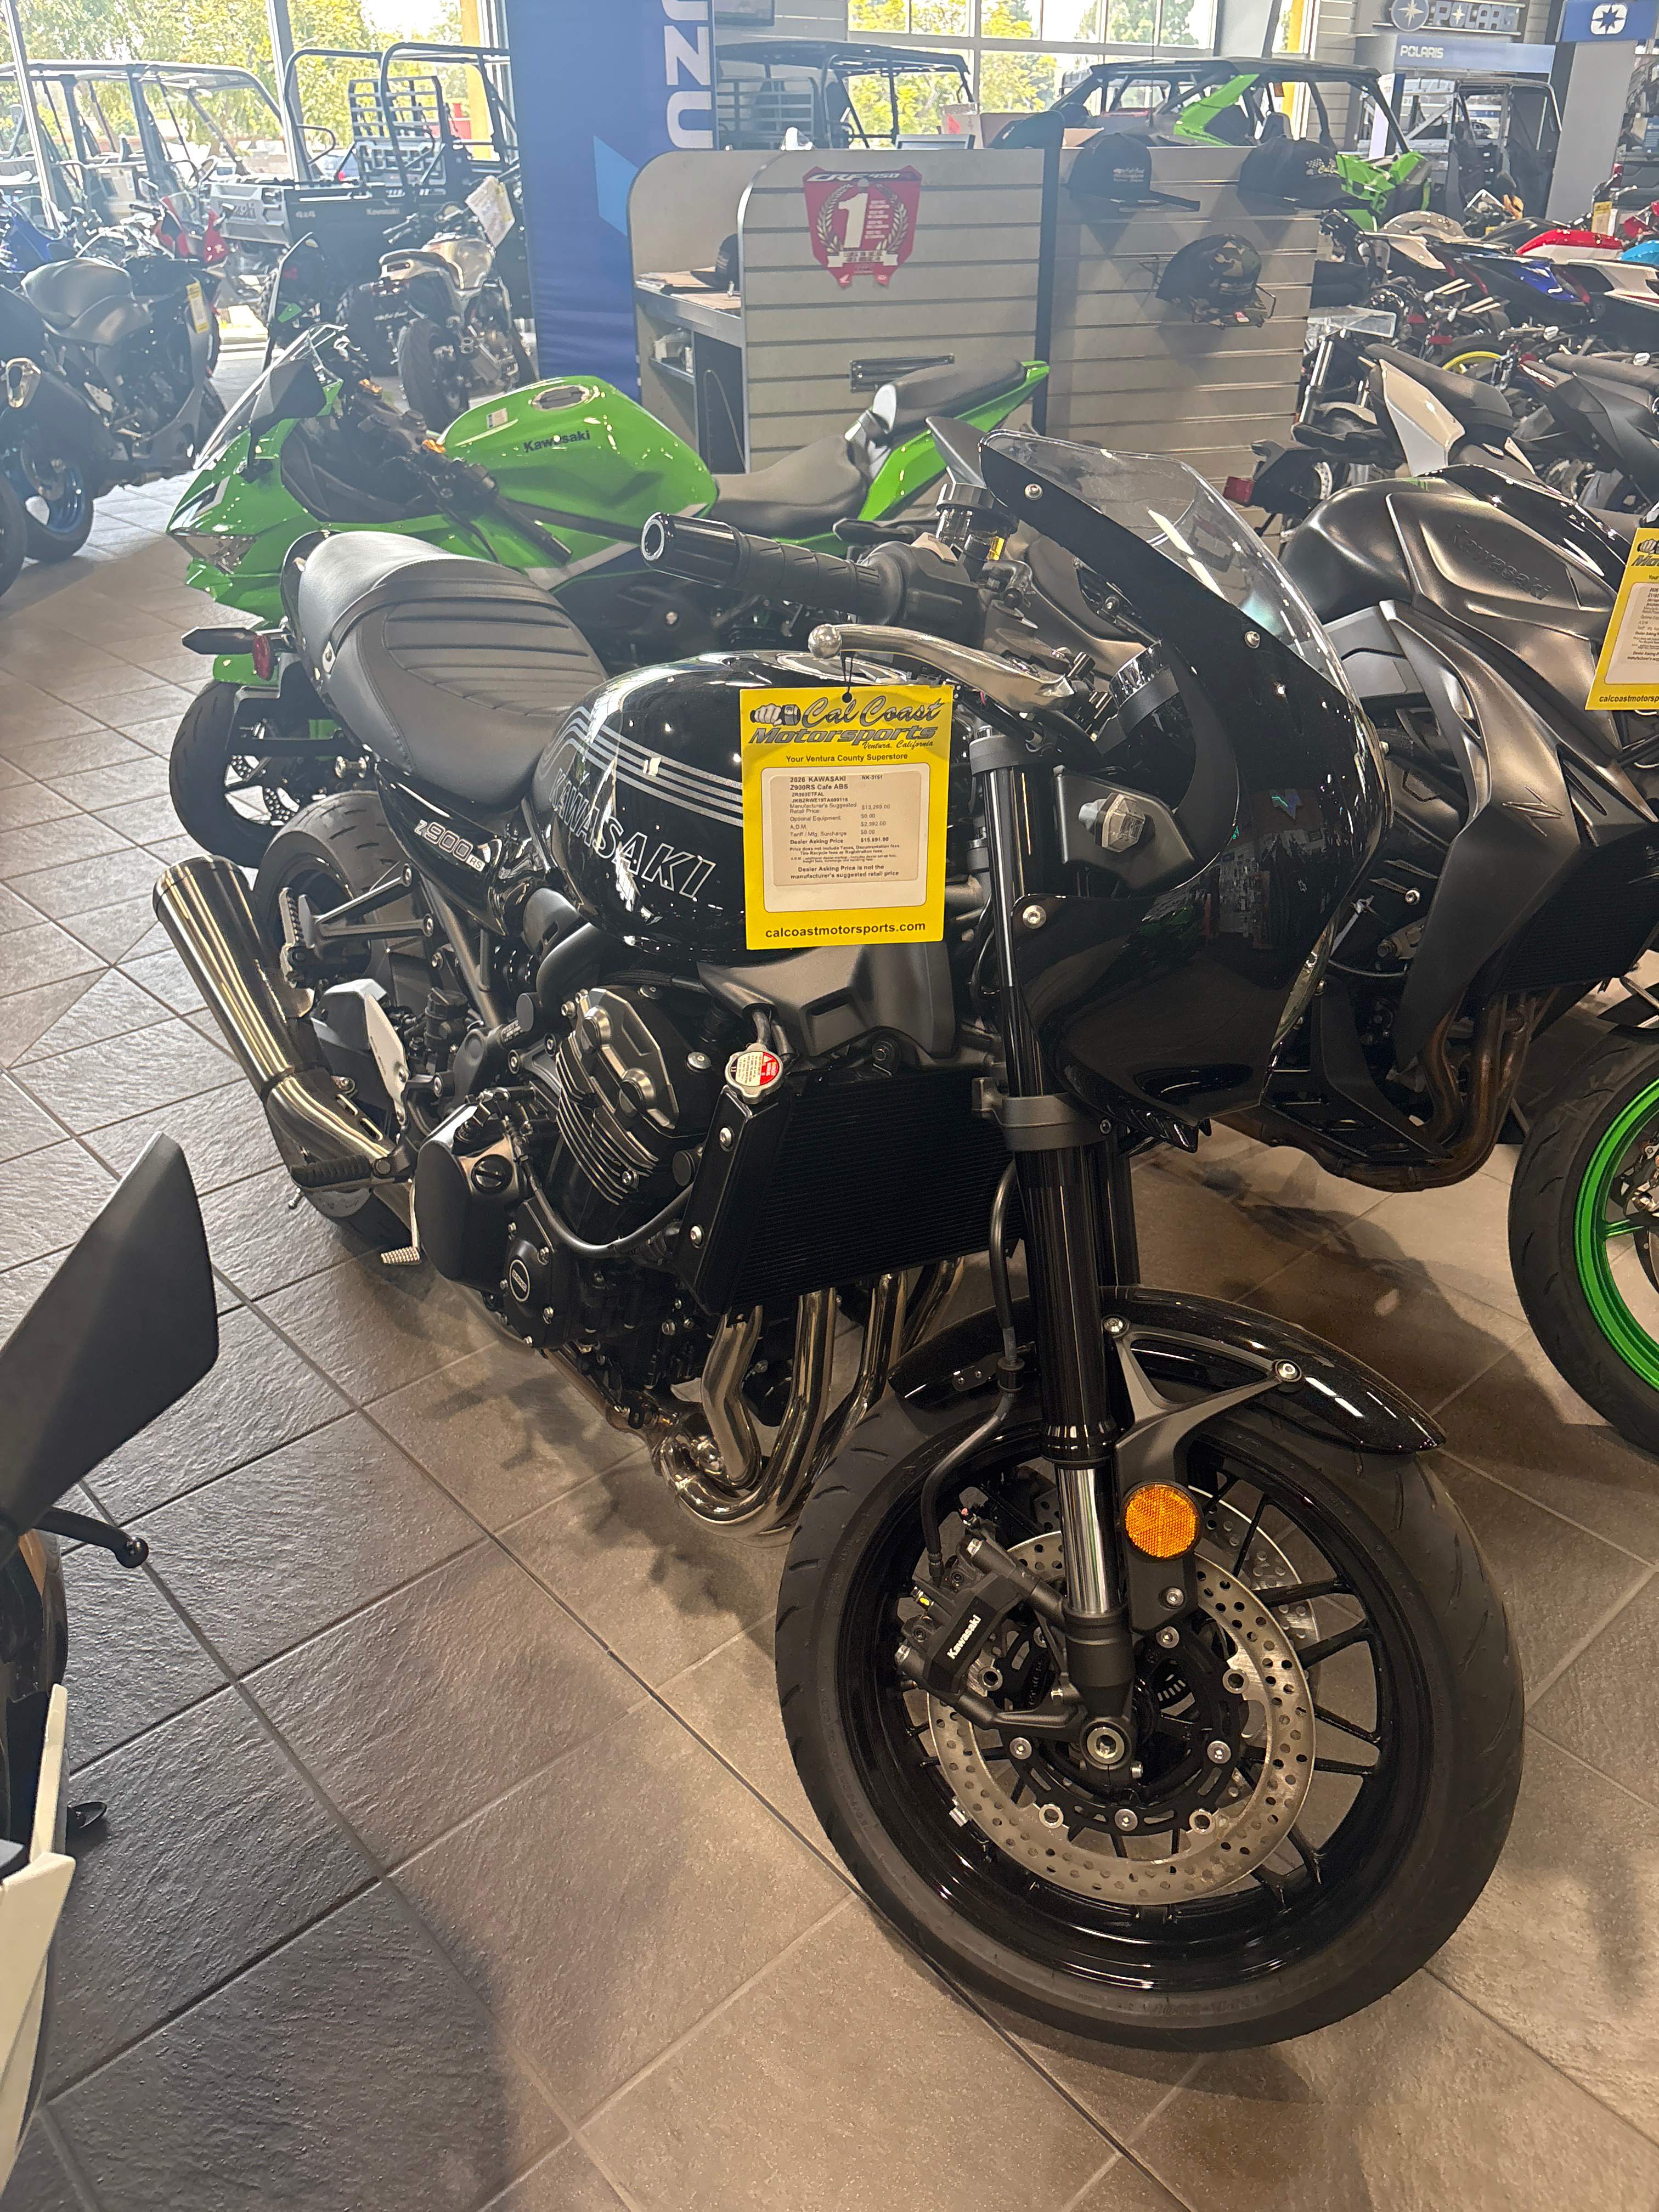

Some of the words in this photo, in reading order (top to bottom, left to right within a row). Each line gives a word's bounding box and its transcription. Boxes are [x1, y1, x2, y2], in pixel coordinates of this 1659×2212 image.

[1400, 45, 1443, 59] POLARIS
[838, 193, 868, 249] 1
[1631, 555, 1659, 567] Mo
[802, 697, 859, 728] Cal
[860, 696, 945, 727] Coast
[748, 725, 939, 746] Motorsports
[896, 740, 933, 750] California
[549, 768, 716, 899] KAWASAKI
[765, 922, 926, 938] calcoastmotorsports.com
[512, 1271, 527, 1290] DOHC
[947, 1614, 981, 1660] Kawasaki
